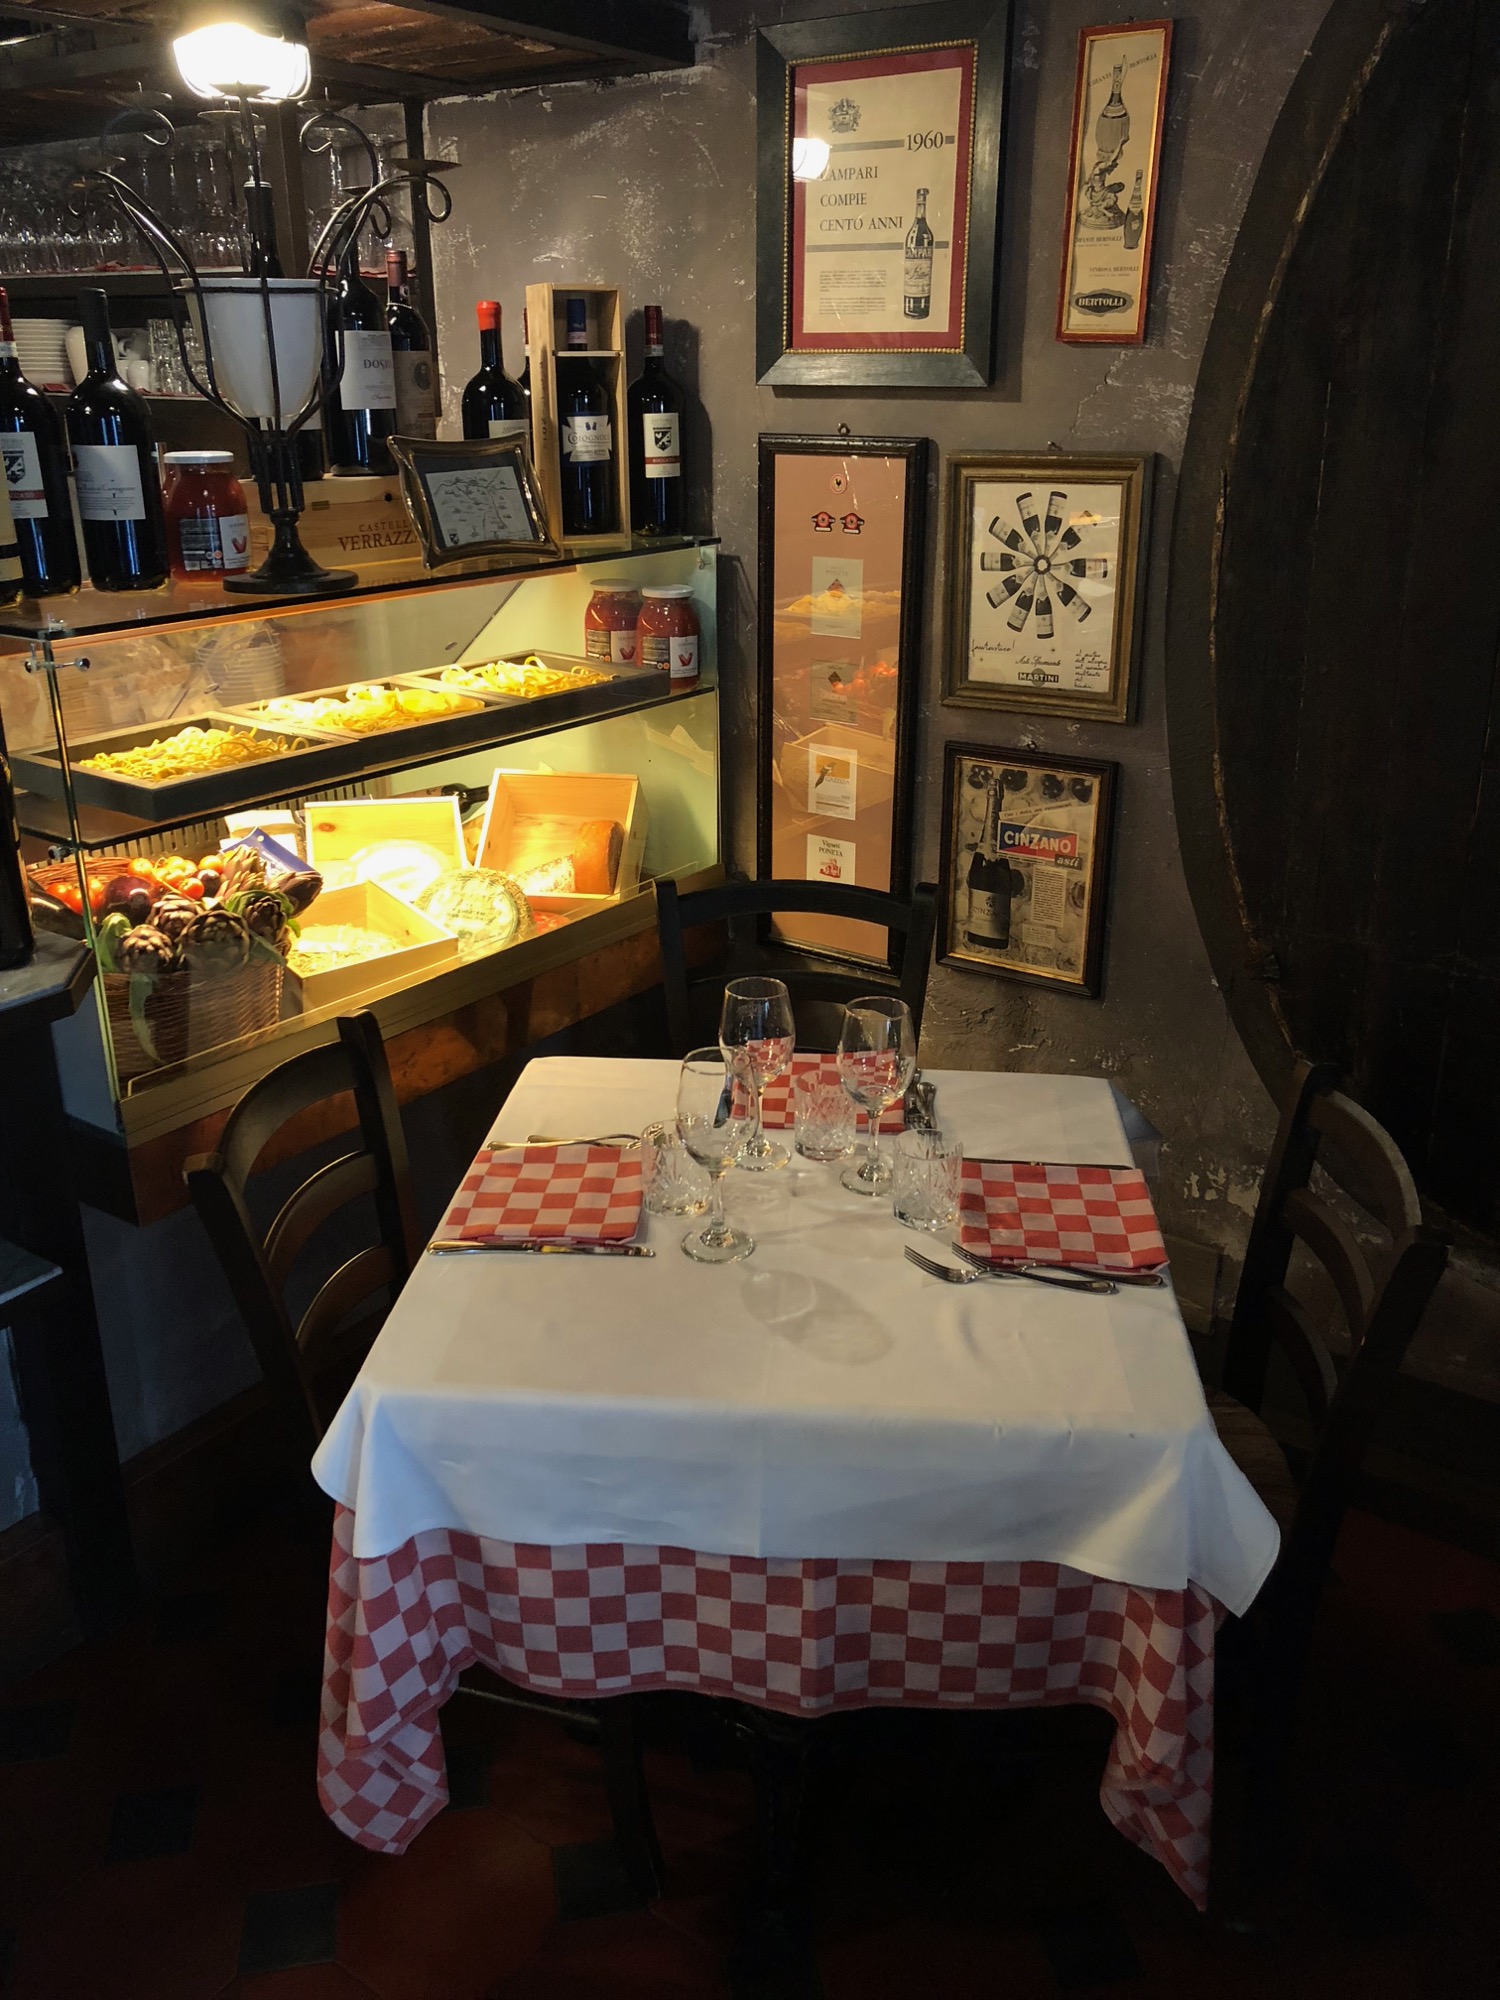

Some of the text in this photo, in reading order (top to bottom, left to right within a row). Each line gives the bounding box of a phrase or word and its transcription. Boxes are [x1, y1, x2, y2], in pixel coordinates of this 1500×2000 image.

[907, 130, 944, 152] 1960
[820, 193, 867, 207] COMPIE
[820, 216, 903, 231] CENTO ANNI
[1078, 298, 1123, 306] BERTOLLI
[358, 520, 412, 532] CASTELL
[1019, 673, 1059, 683] MARTINI
[1003, 830, 1072, 854] CINZANO
[819, 847, 843, 857] PONETA
[1057, 856, 1080, 868] asti
